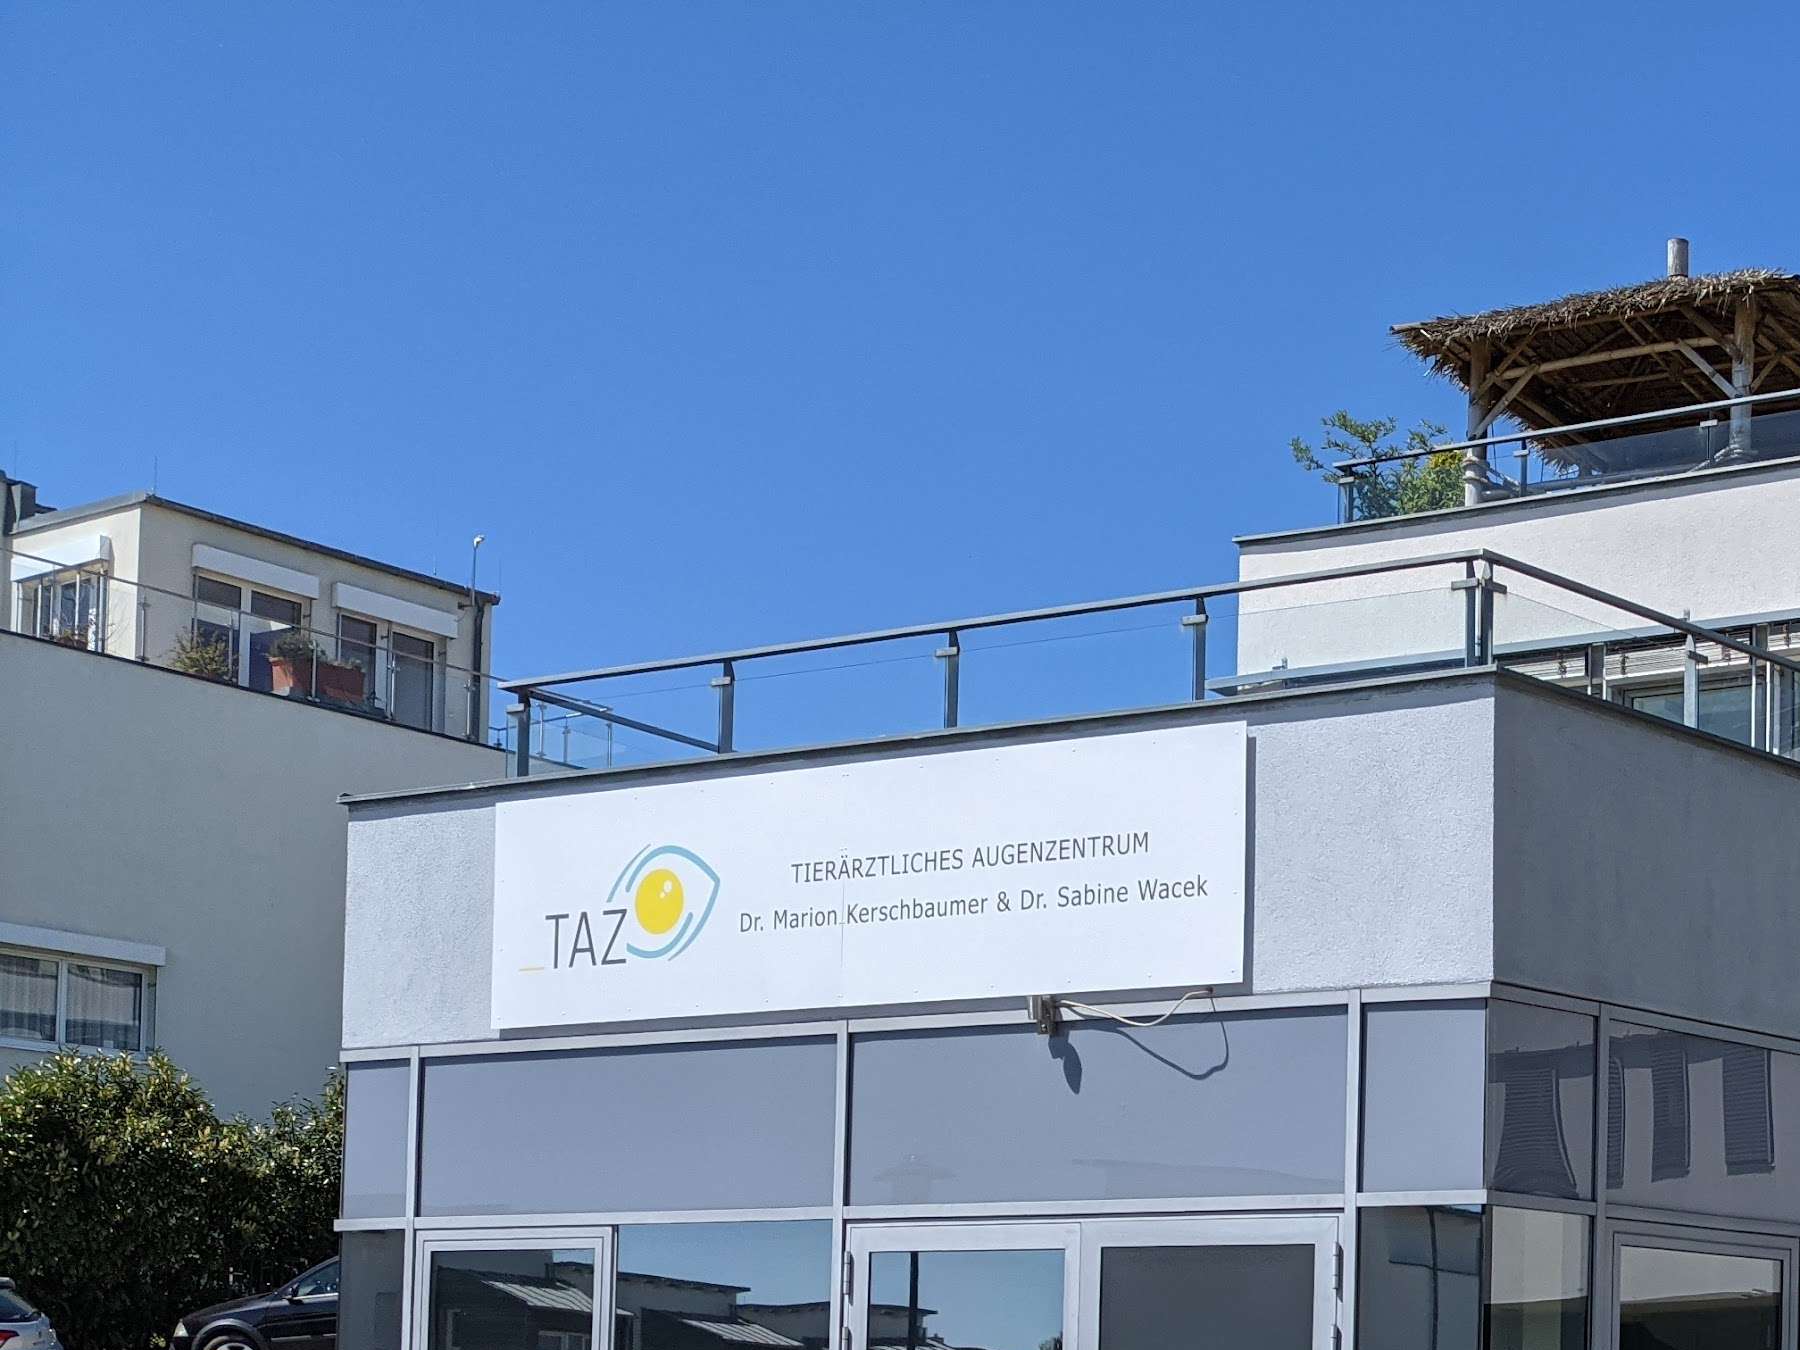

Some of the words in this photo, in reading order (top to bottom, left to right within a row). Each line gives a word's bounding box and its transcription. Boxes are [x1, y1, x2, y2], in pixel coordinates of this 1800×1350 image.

[790, 849, 964, 884] TIERÄRZTLICHES
[971, 831, 1150, 869] AUGENZENTRUM
[739, 912, 765, 933] Dr.
[773, 906, 838, 930] Marion
[846, 897, 989, 925] Kerschbaumer
[996, 890, 1012, 913] &
[1020, 888, 1048, 911] Dr.
[1057, 882, 1129, 908] Sabine
[1137, 874, 1209, 902] Wacek
